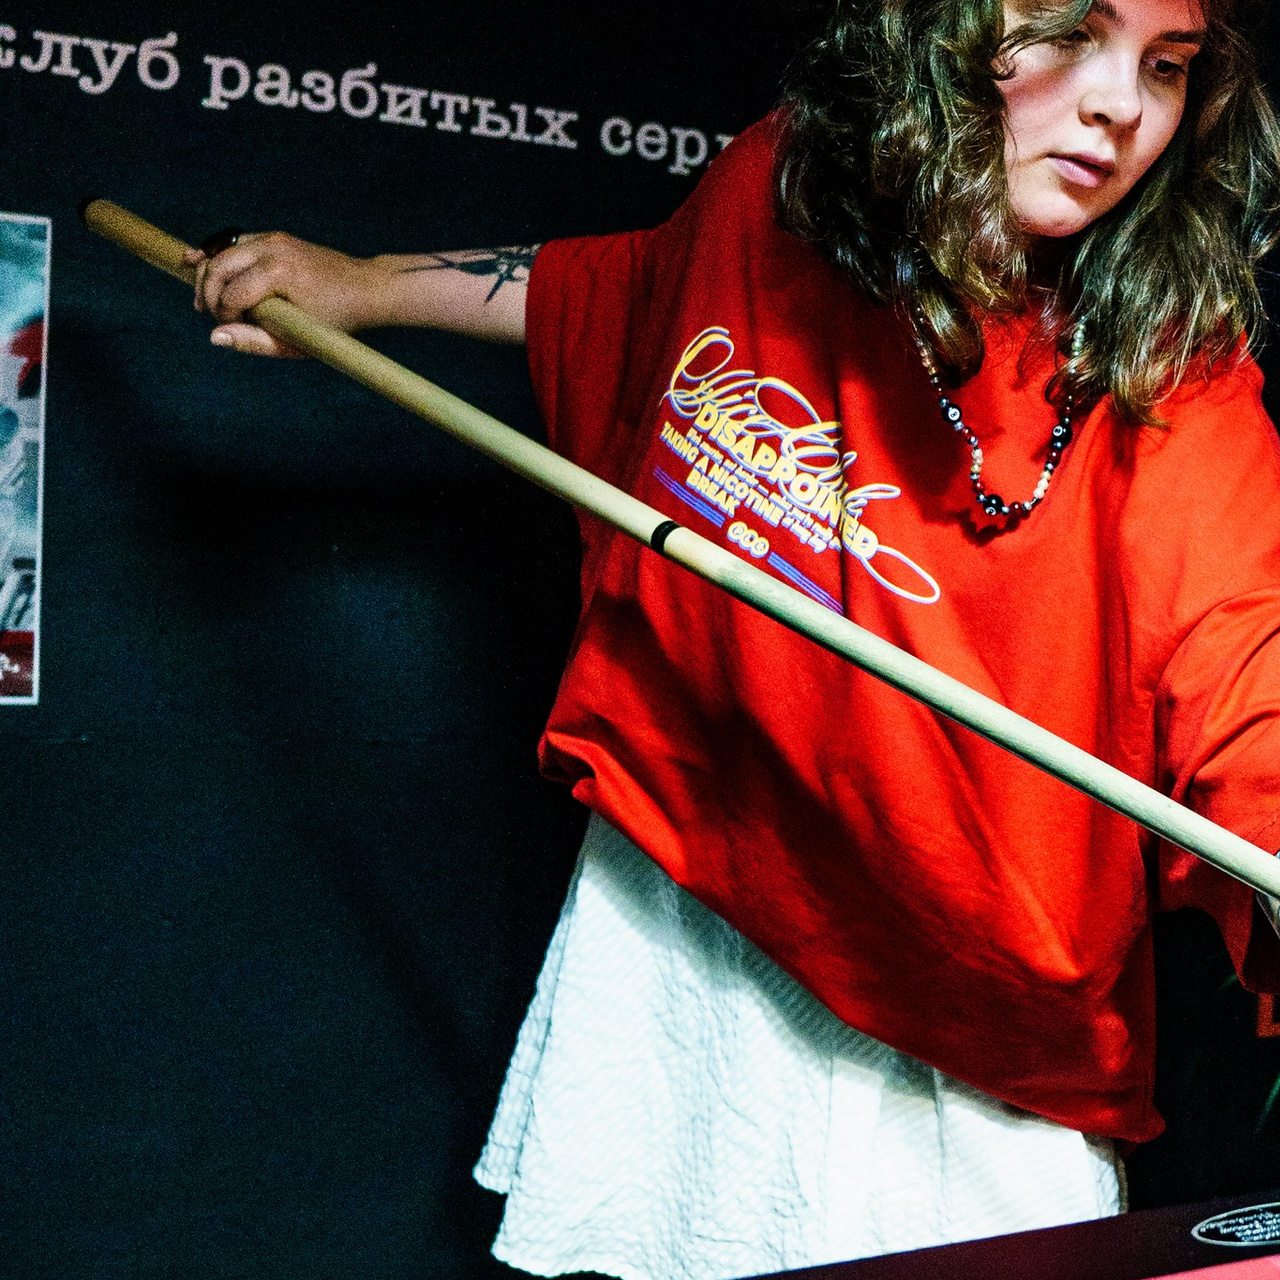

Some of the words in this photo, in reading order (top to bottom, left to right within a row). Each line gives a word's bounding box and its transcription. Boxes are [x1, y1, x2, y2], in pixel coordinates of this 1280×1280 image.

[201, 53, 578, 149] разбитых
[600, 116, 735, 176] сер
[660, 420, 700, 465] TAKING
[694, 455, 710, 477] A
[707, 463, 786, 527] NICOTINE
[685, 467, 741, 518] BREAK
